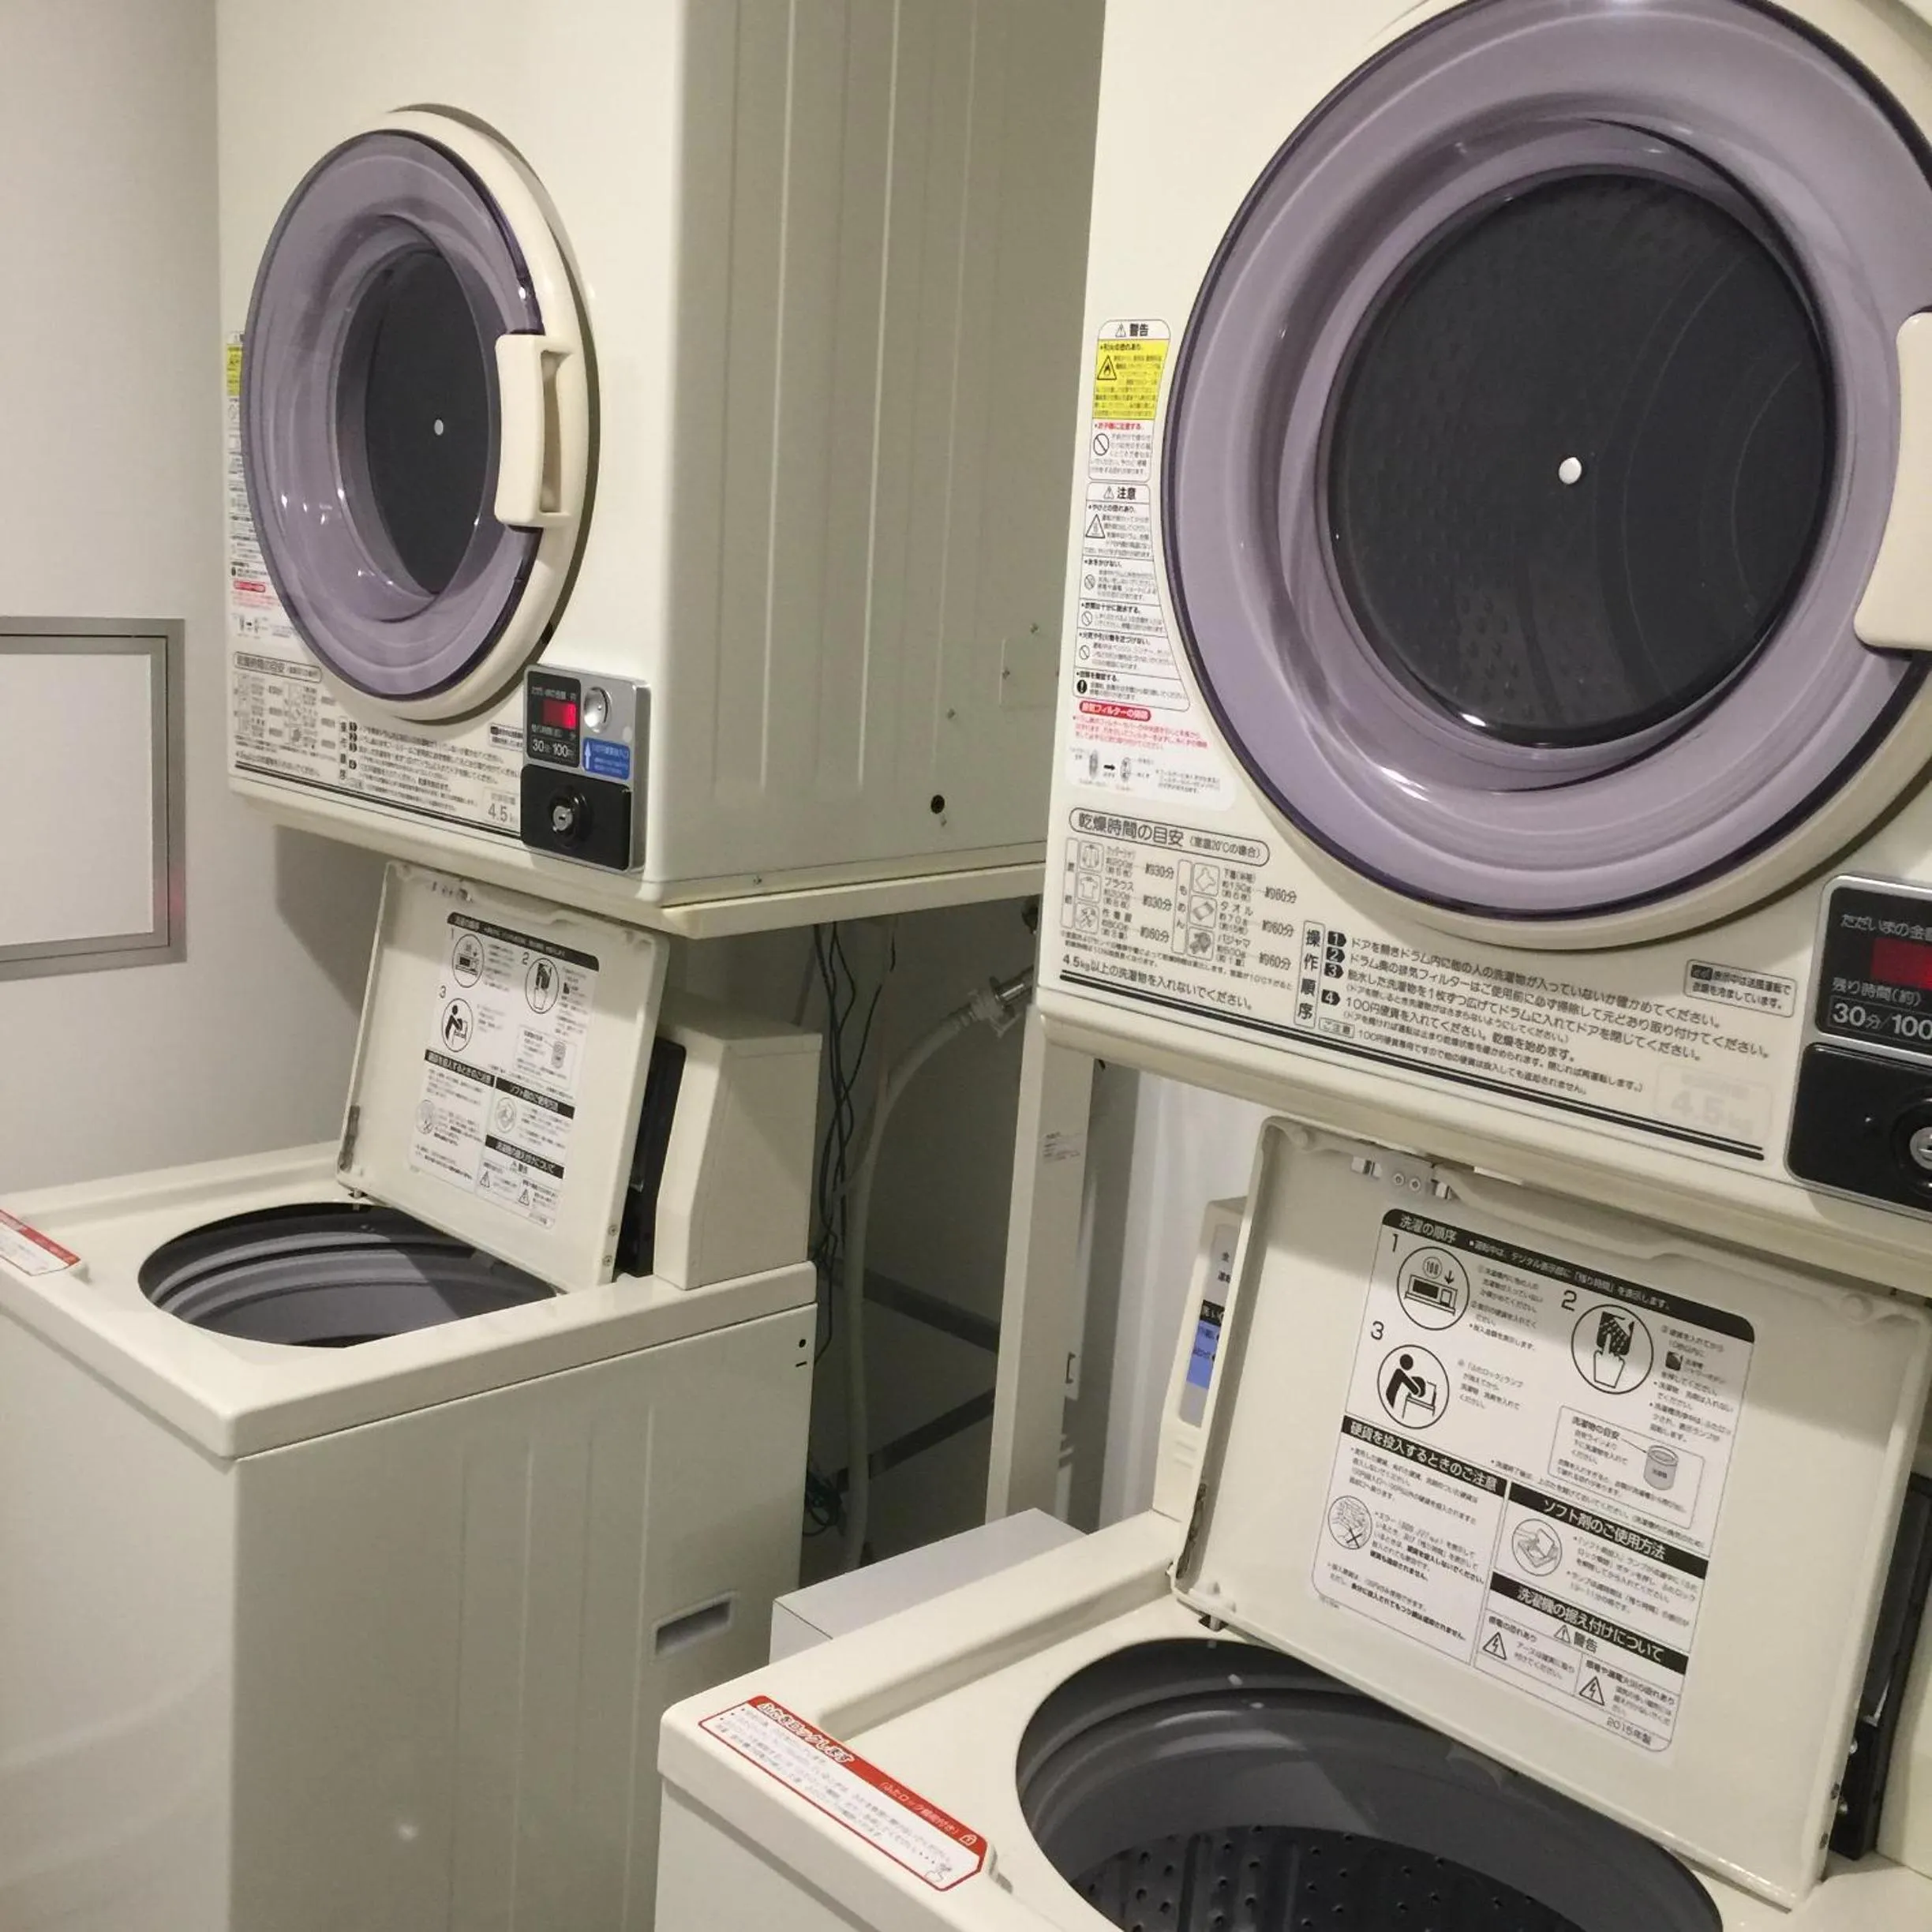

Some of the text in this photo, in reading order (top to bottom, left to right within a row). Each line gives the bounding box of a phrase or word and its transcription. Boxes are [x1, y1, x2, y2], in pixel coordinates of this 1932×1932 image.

[1129, 324, 1148, 336] 警告
[1117, 486, 1136, 500] 注意
[1078, 812, 1184, 847] 乾燥時間の目安
[522, 952, 530, 965] 2
[1063, 954, 1252, 1009] 4.5kg以上の洗濯物を入れないでください。
[1297, 928, 1321, 1020] 操作順序
[439, 986, 447, 999] 3
[1398, 1215, 1457, 1244] 洗濯の順序
[1391, 1234, 1398, 1252] 1
[1561, 1290, 1577, 1312] 2
[1370, 1320, 1384, 1340] 3
[1350, 1421, 1497, 1492] 硬貨を投入するときのご注意
[1544, 1500, 1666, 1559] ソフト剤のご使用方法
[1517, 1586, 1664, 1662] 洗濯機の据え付けについて
[1574, 1632, 1598, 1653] 警告
